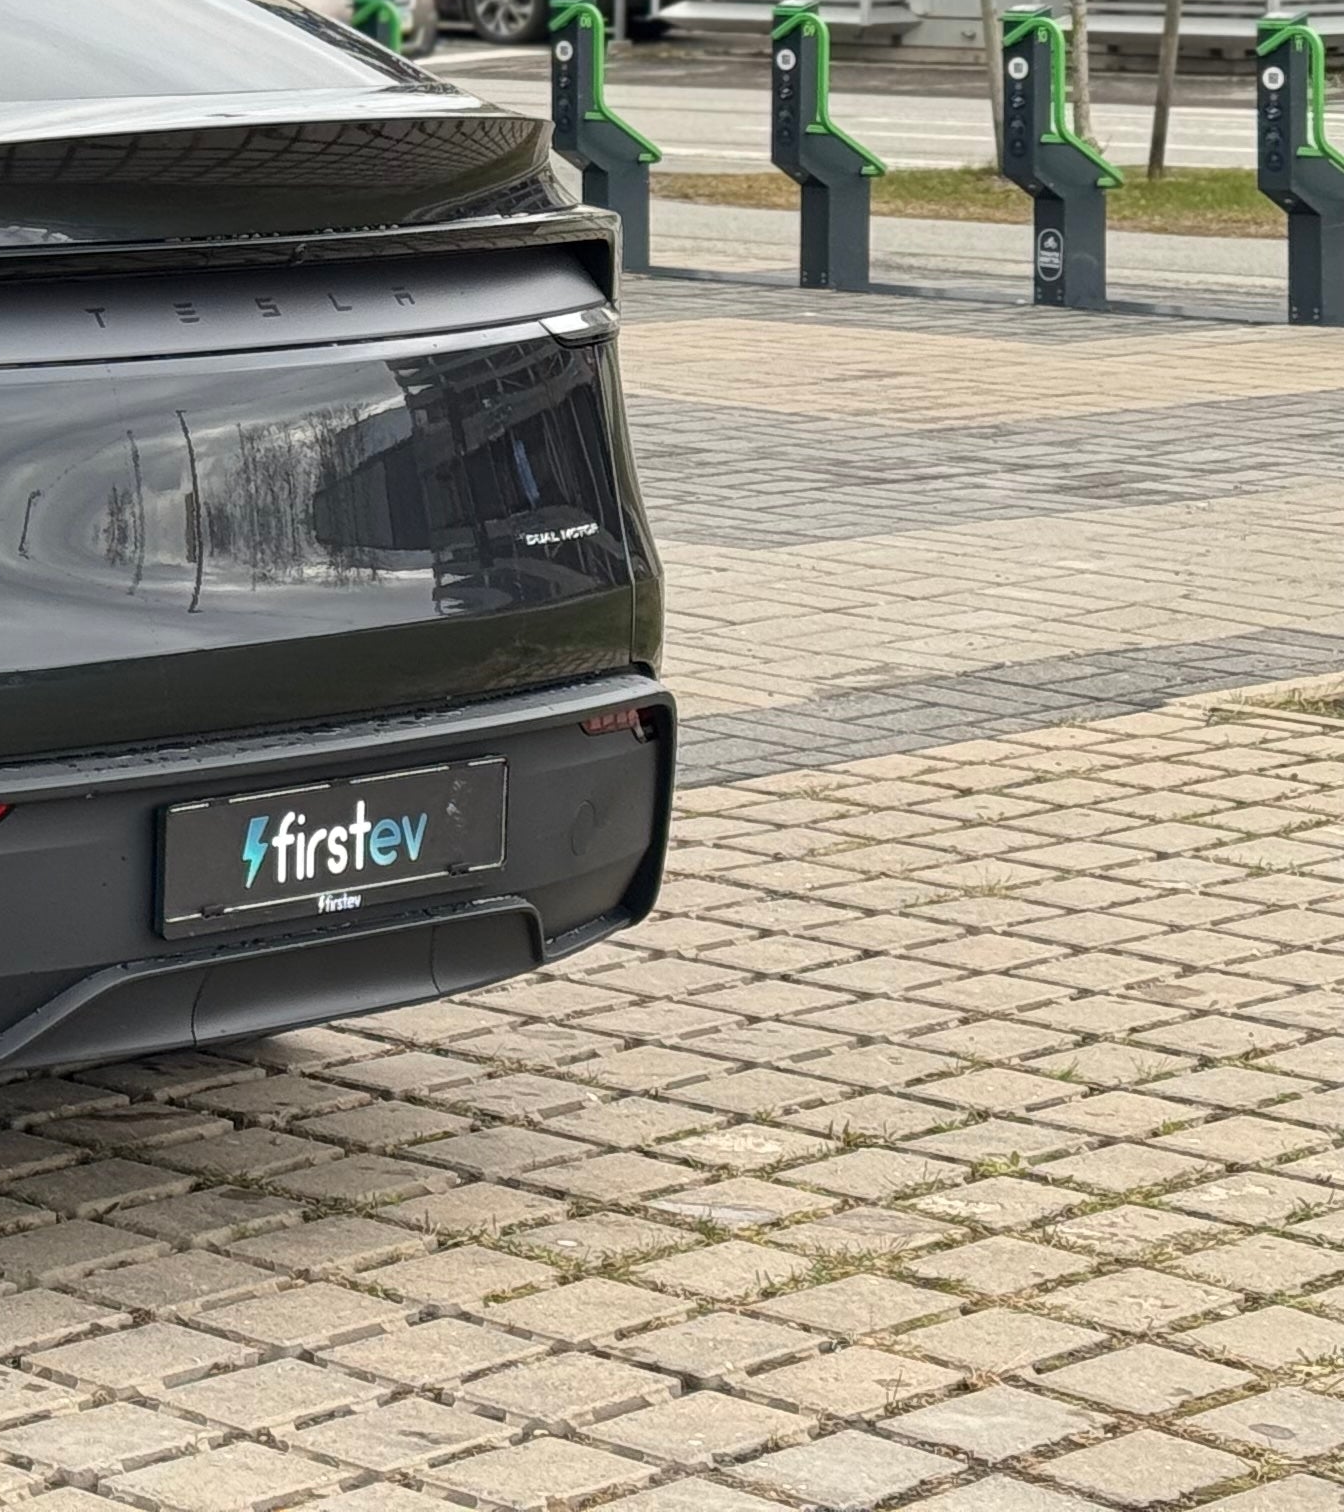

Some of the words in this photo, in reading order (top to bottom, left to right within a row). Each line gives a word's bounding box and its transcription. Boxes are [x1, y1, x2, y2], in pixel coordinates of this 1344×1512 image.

[85, 286, 416, 329] TESLA
[525, 530, 560, 546] DUAL
[272, 800, 428, 884] firstev
[325, 892, 362, 913] firstev
